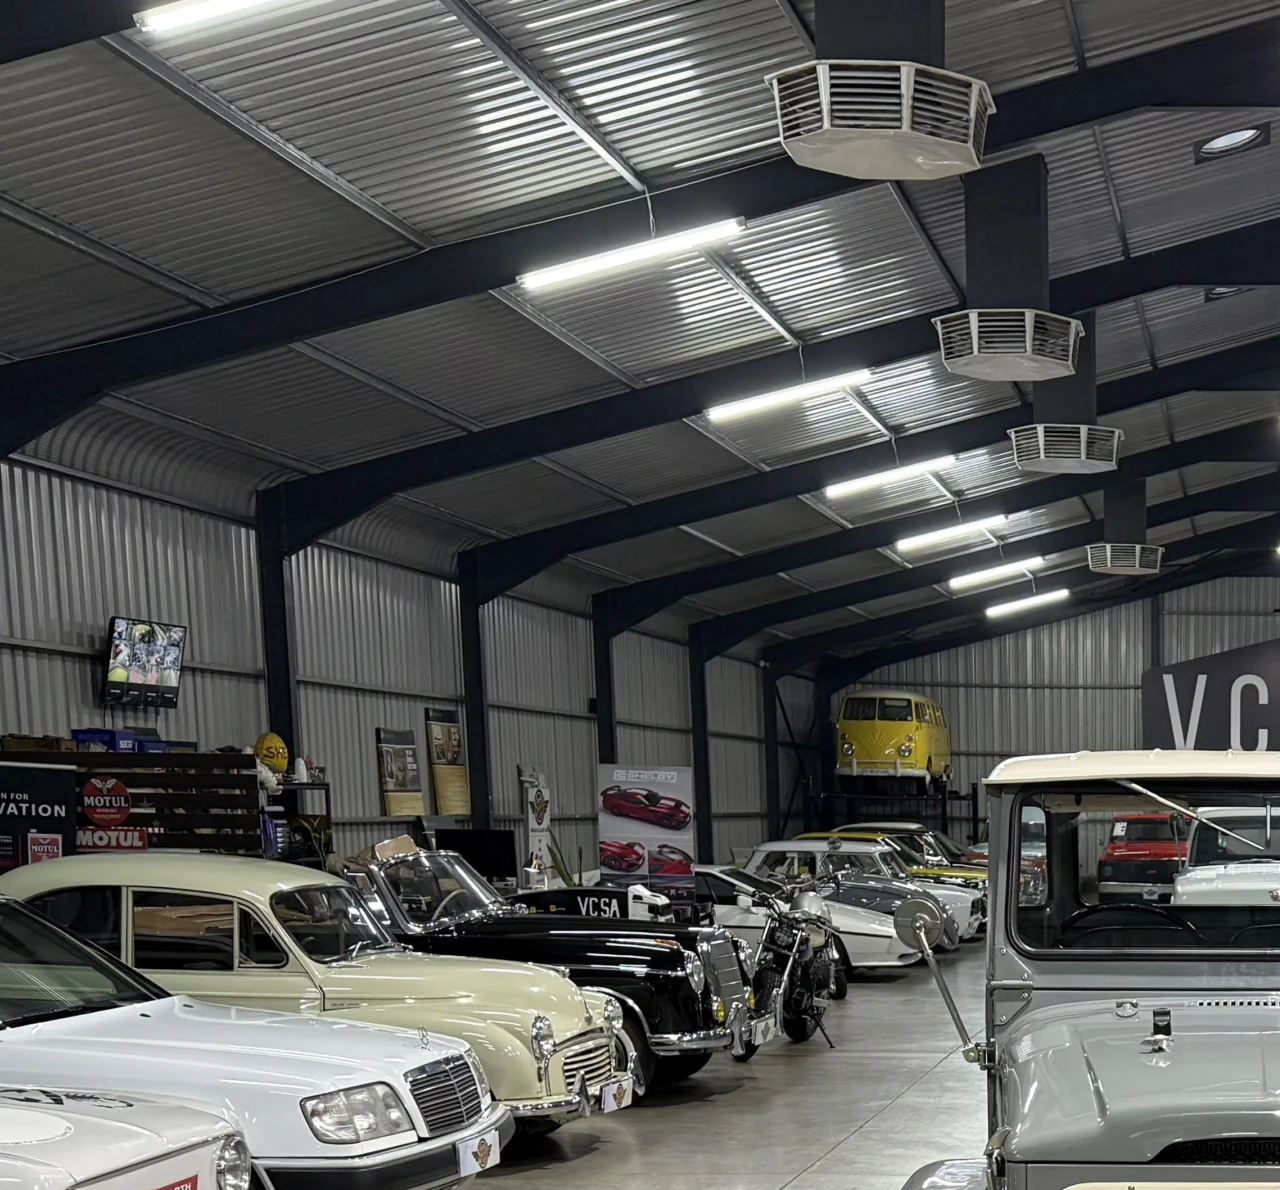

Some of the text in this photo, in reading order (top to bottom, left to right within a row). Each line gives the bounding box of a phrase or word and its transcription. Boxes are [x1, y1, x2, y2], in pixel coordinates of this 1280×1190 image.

[10, 793, 29, 801] FOR
[83, 796, 129, 807] MOTUL
[76, 830, 143, 847] MOTUL
[31, 845, 59, 853] MOTUL
[577, 896, 620, 918] VCSA
